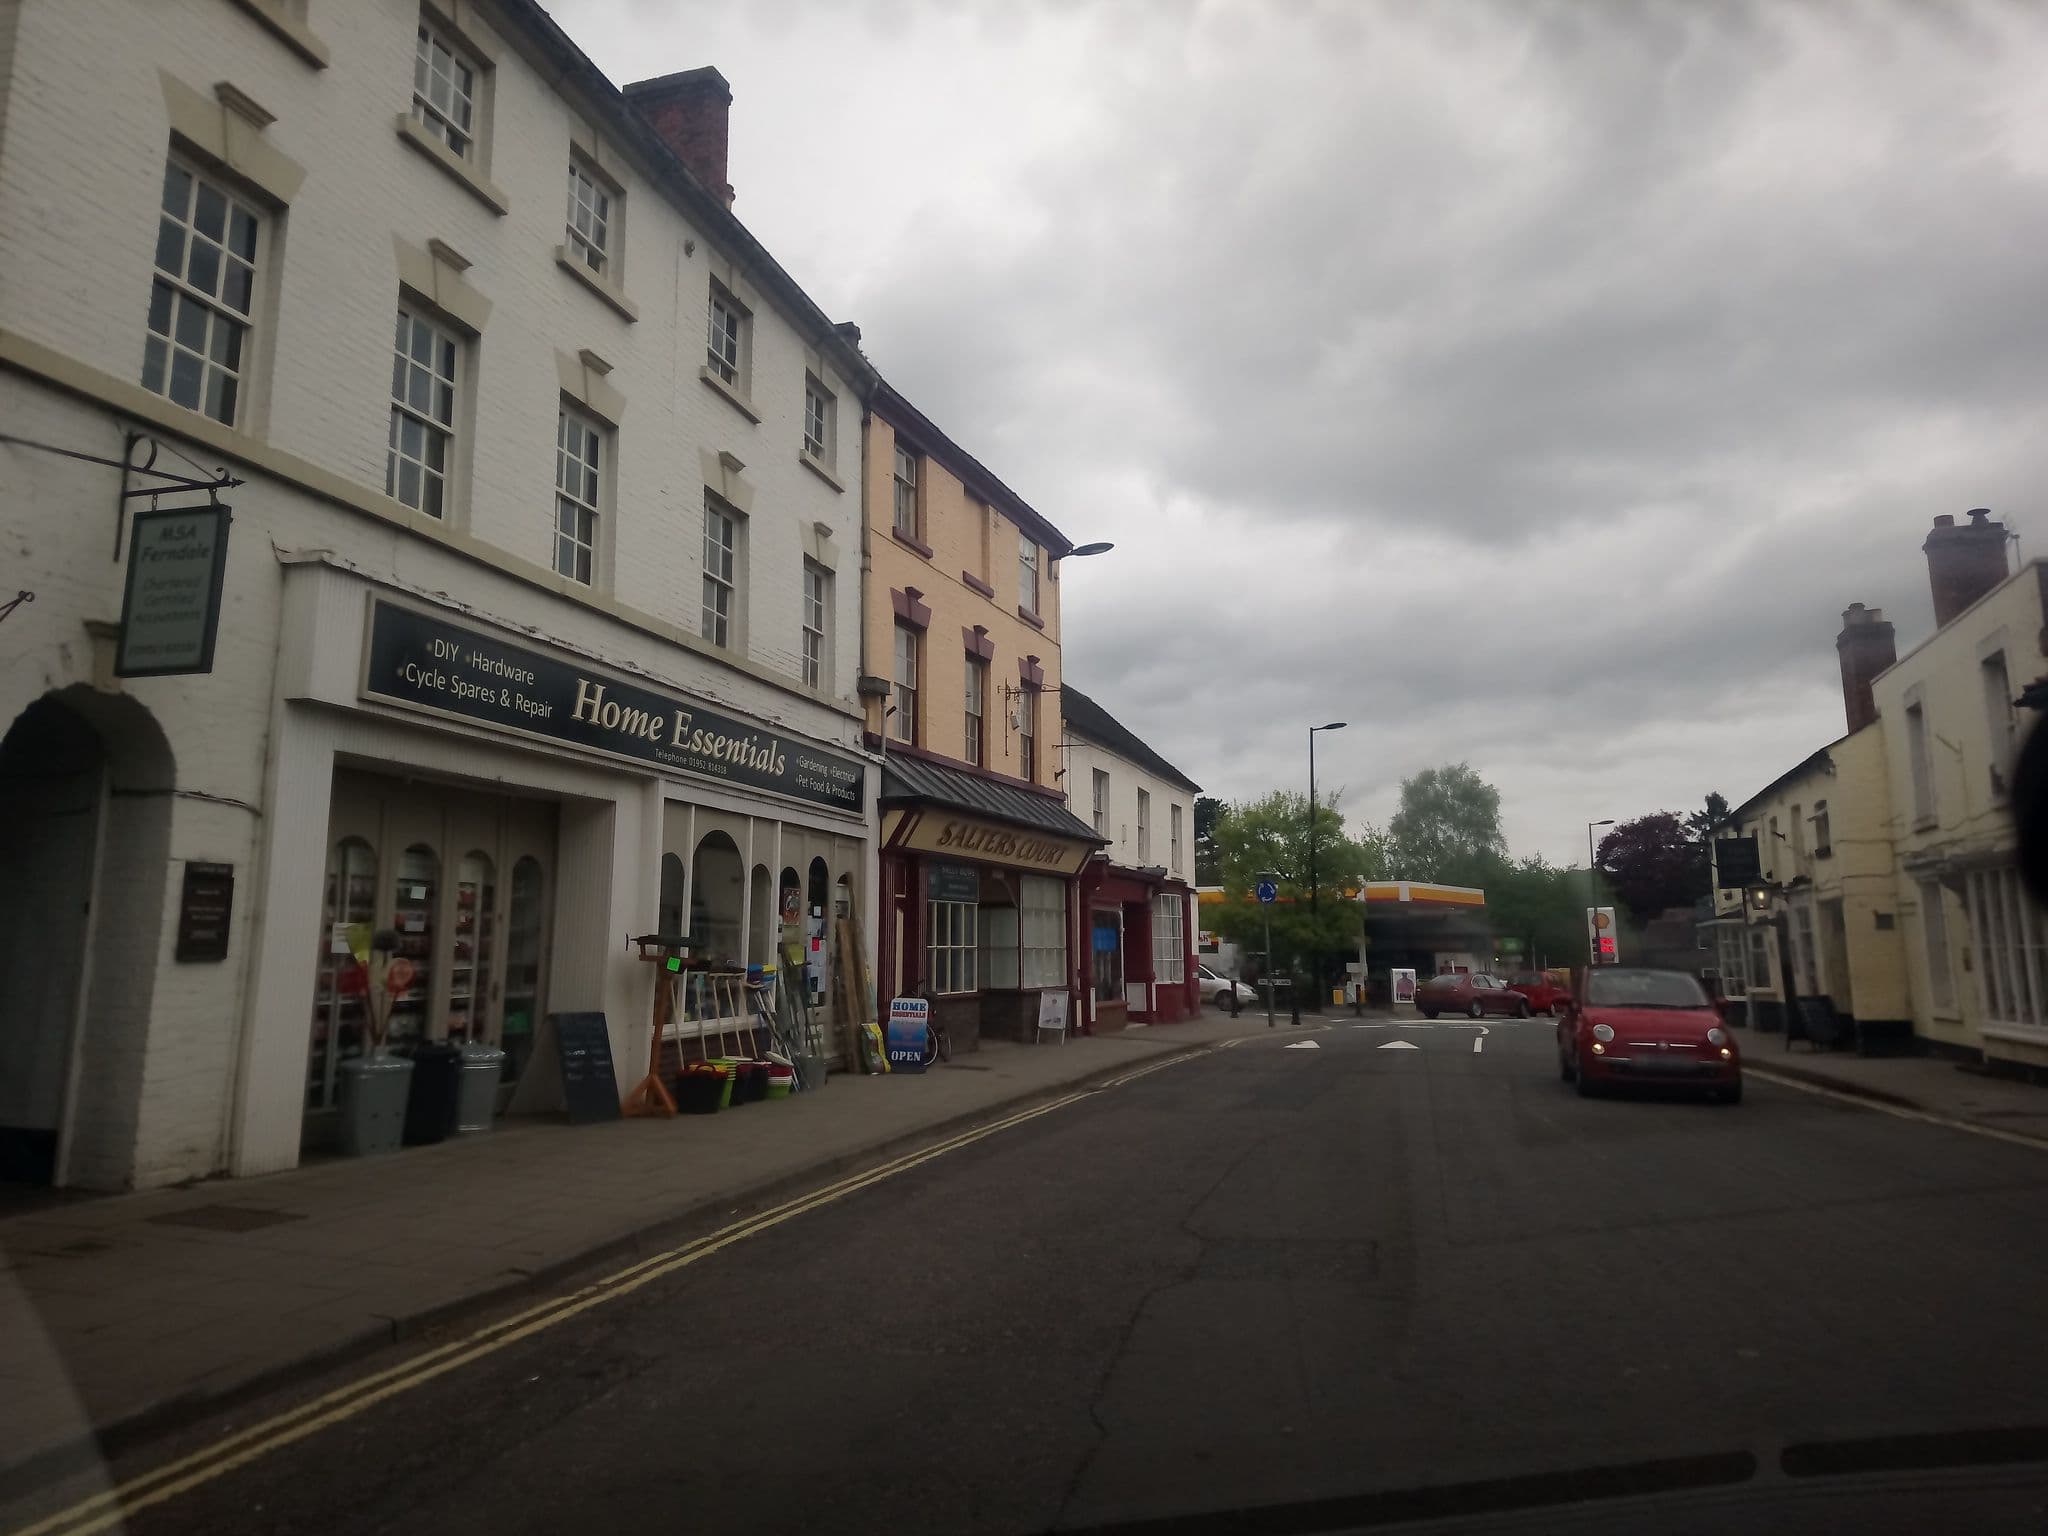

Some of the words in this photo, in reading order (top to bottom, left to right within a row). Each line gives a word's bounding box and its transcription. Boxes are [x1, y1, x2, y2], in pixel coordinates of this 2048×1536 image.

[434, 638, 460, 662] DIY
[472, 651, 535, 686] Hardware
[406, 663, 446, 689] Cycle
[450, 675, 496, 704] Spares
[500, 688, 511, 708] &
[515, 693, 553, 719] Repair
[570, 678, 665, 742] Home
[671, 709, 787, 777] Essentials
[655, 748, 687, 765] Telephone
[688, 757, 706, 770] 01952
[800, 755, 828, 778] Gardening
[832, 766, 856, 784] Electrical
[798, 774, 809, 788] Pet
[810, 777, 825, 792] Food
[826, 782, 831, 794] &
[831, 784, 857, 801] Products
[937, 822, 1017, 856] SALTERS
[1016, 837, 1071, 866] COURT
[892, 1001, 927, 1011] HOME
[891, 1050, 921, 1061] OPEN
